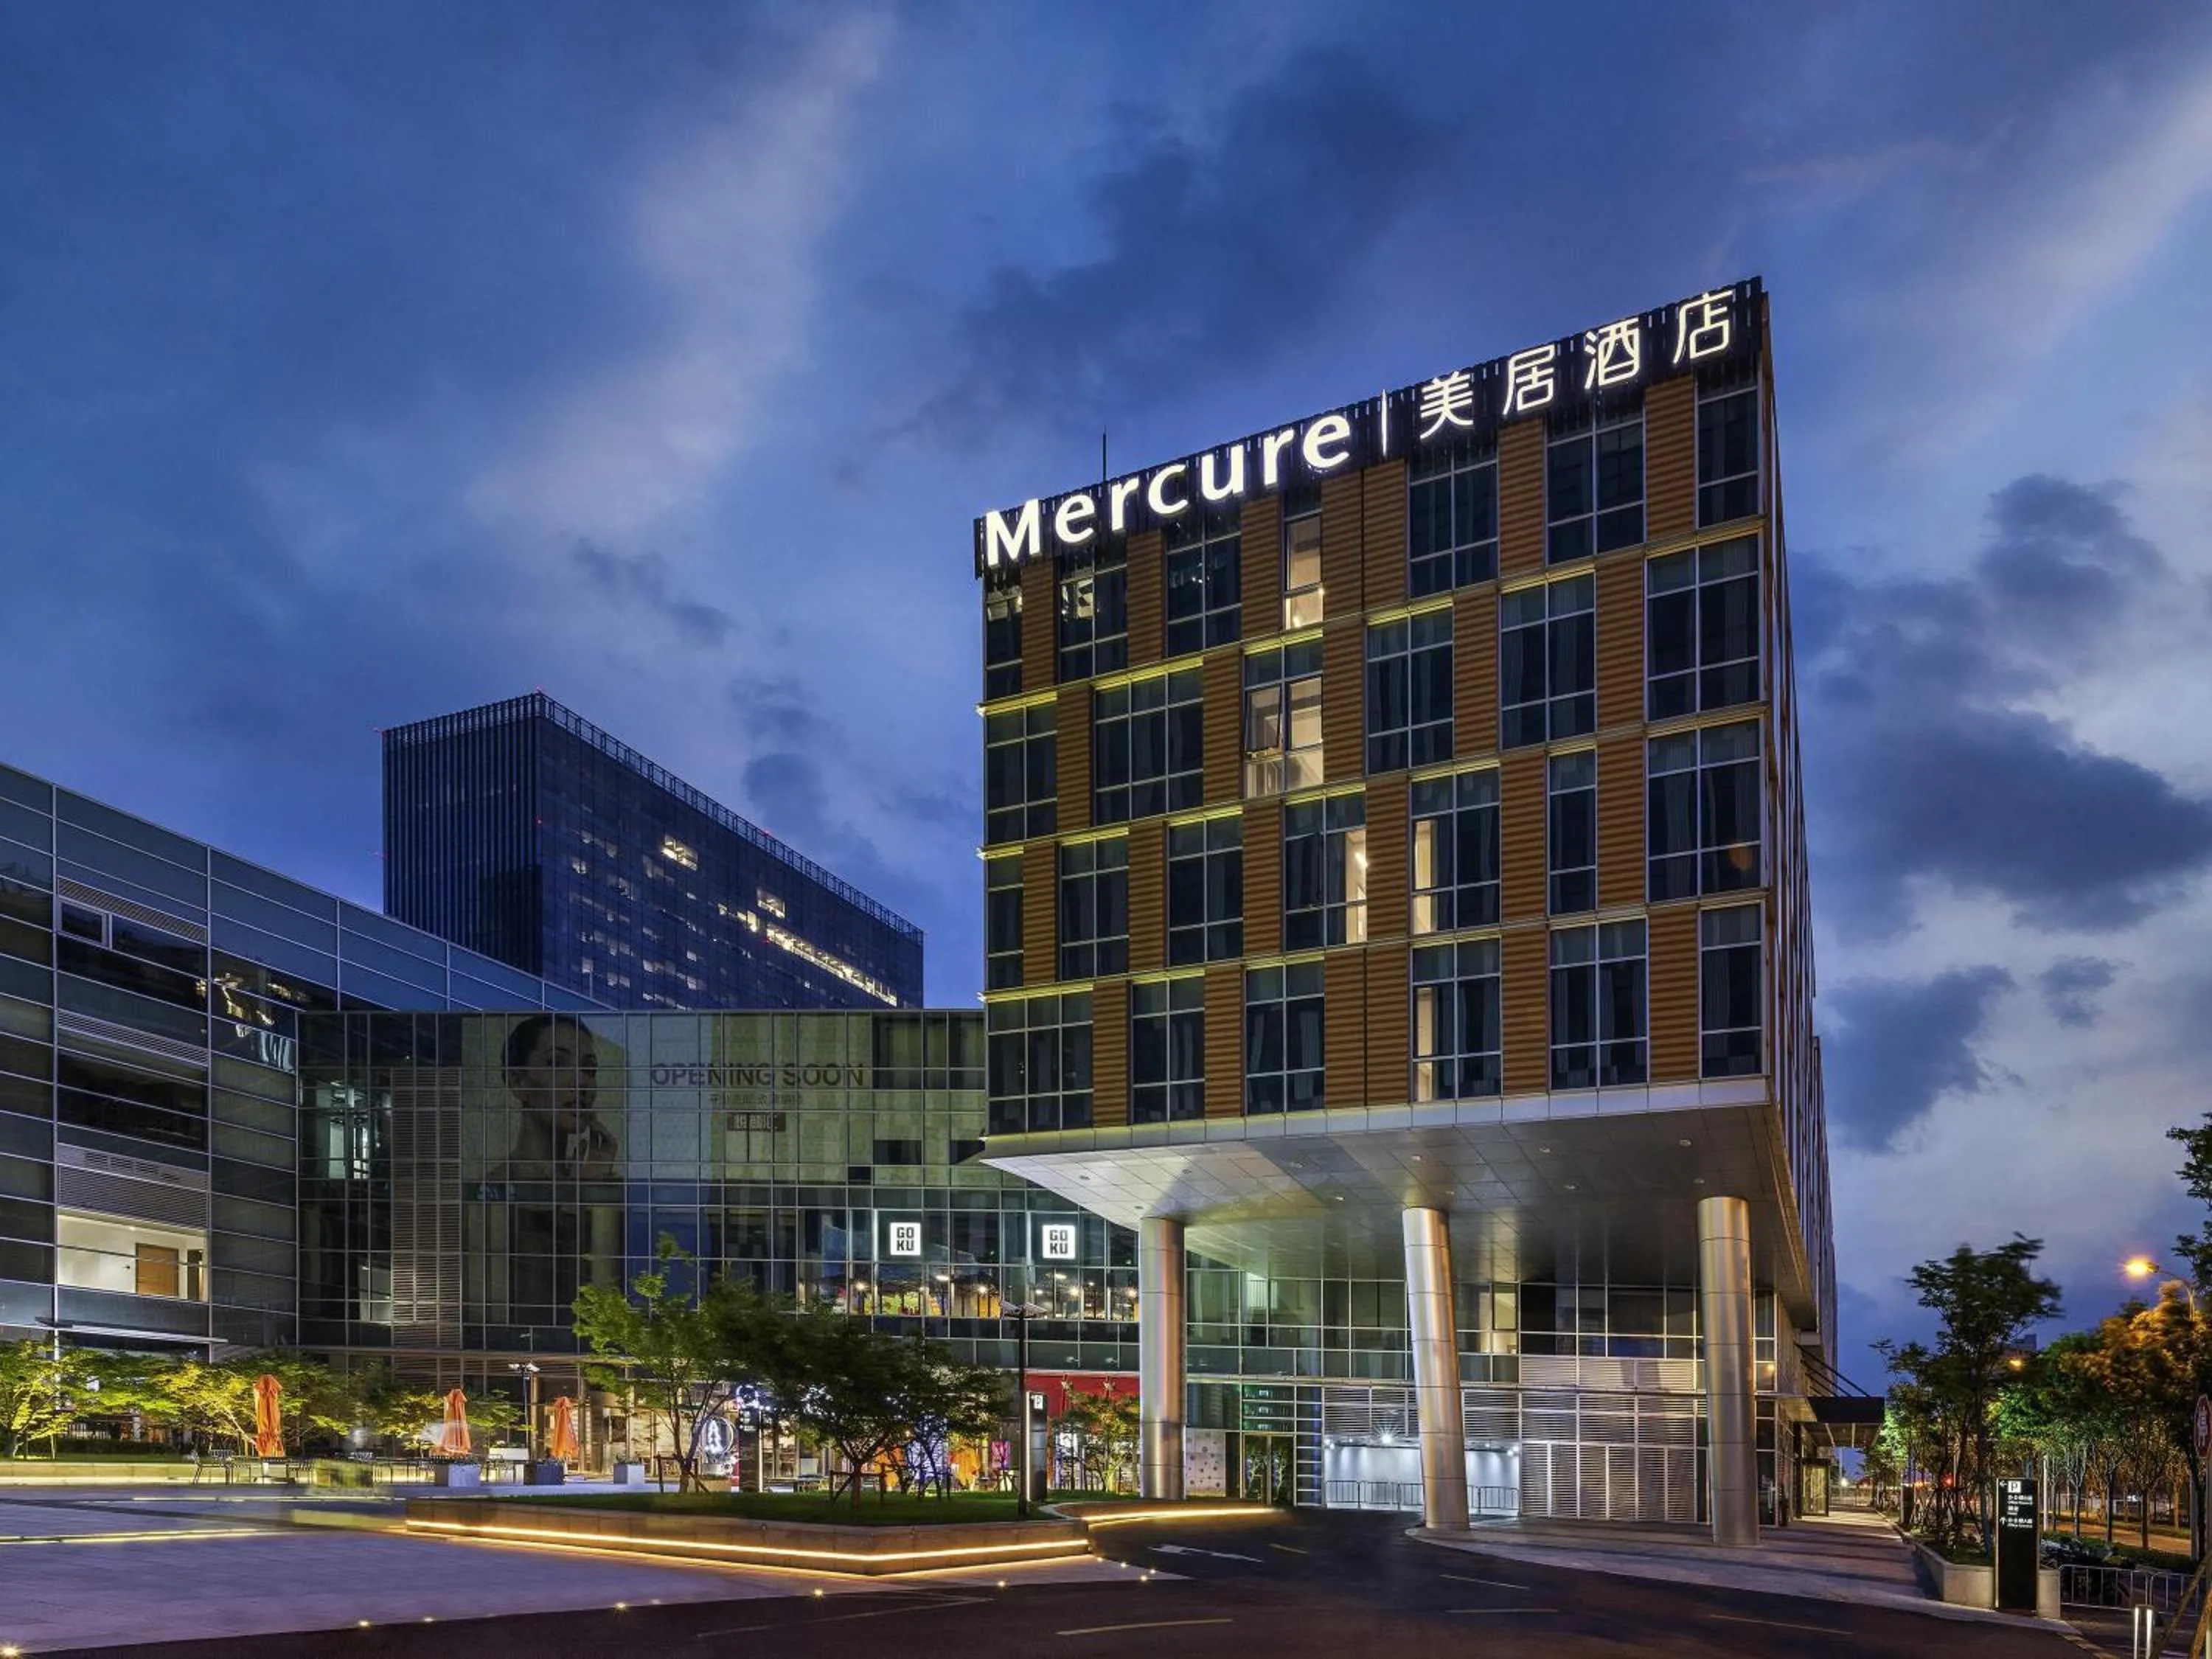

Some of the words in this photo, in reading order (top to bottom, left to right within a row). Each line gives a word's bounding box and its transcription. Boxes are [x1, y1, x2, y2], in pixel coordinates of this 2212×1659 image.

[1419, 289, 1733, 439] 美居酒店
[984, 413, 1352, 566] Mercure
[652, 1063, 774, 1086] OPENING
[782, 1063, 864, 1086] SOON
[897, 1226, 914, 1239] GO
[1049, 1229, 1068, 1241] GO
[897, 1239, 914, 1251] KU
[1049, 1242, 1068, 1254] KU
